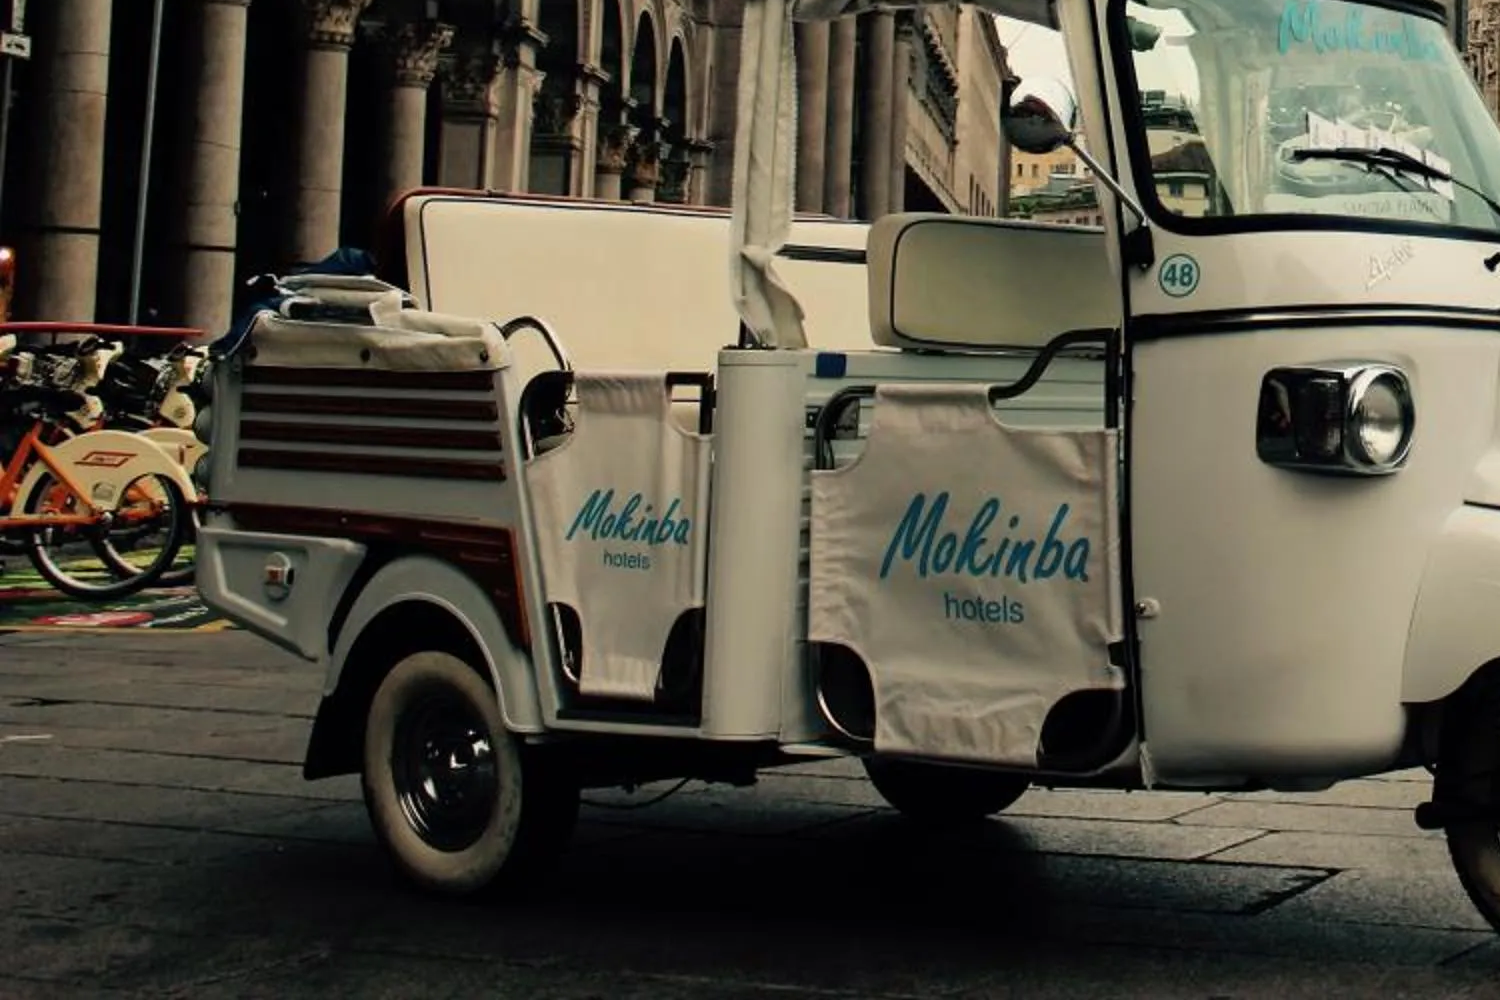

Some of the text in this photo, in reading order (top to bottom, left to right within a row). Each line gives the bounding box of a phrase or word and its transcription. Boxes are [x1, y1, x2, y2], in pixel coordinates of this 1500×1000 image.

[1163, 263, 1194, 287] 48
[564, 488, 690, 546] Mokinba
[879, 491, 1091, 585] Mokinba
[602, 548, 651, 570] hotels
[943, 592, 1025, 624] hotels
